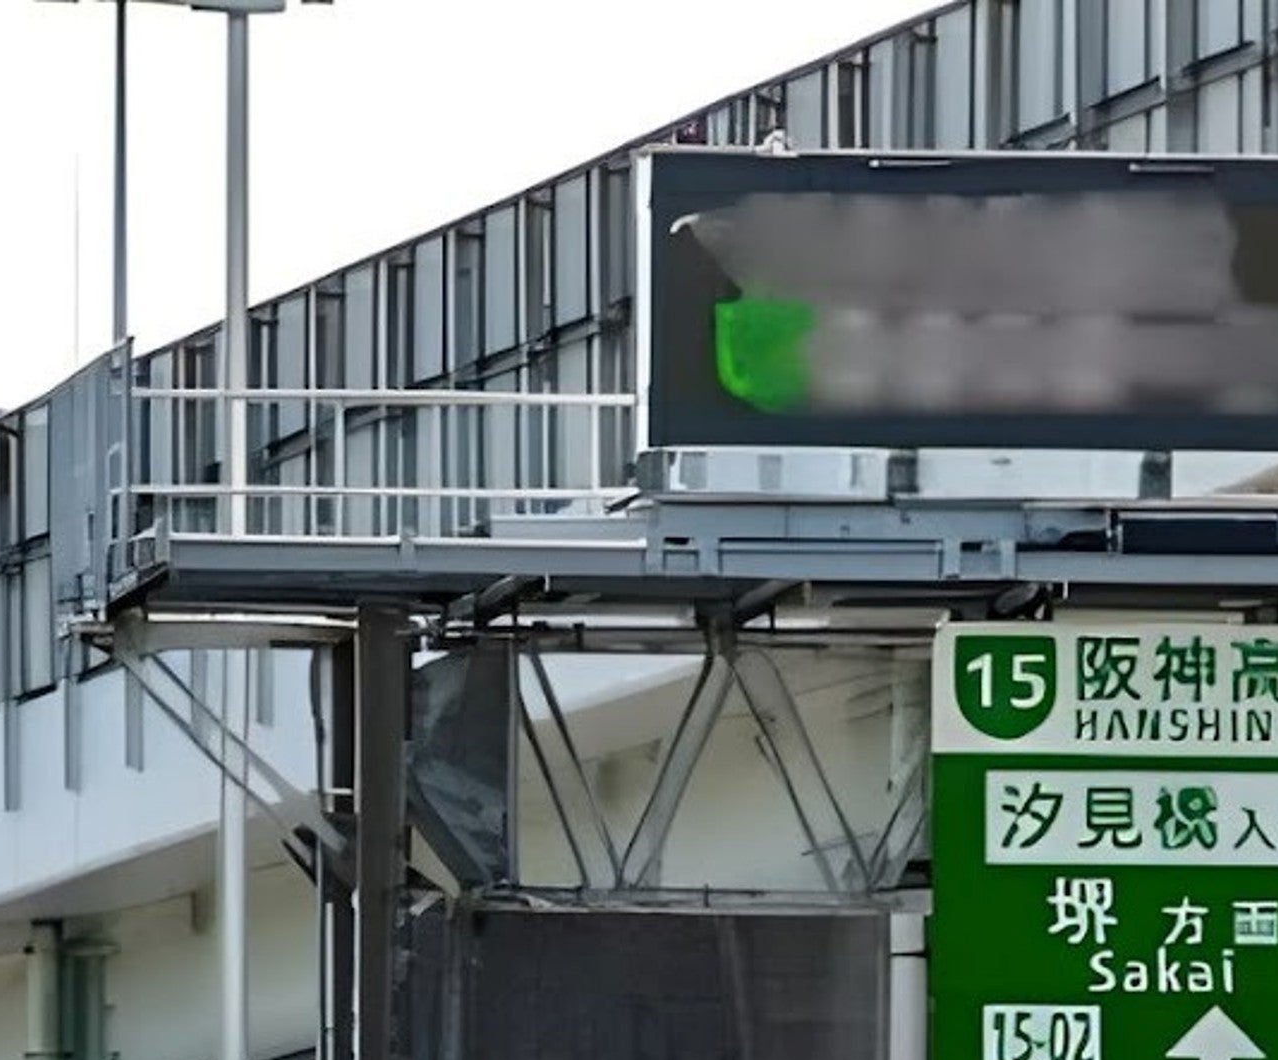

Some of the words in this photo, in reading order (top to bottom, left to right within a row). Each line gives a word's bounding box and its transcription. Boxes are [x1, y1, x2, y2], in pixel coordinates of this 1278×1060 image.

[966, 652, 1047, 708] 15
[1075, 708, 1274, 743] HANSHIN
[1088, 948, 1235, 993] Sakai
